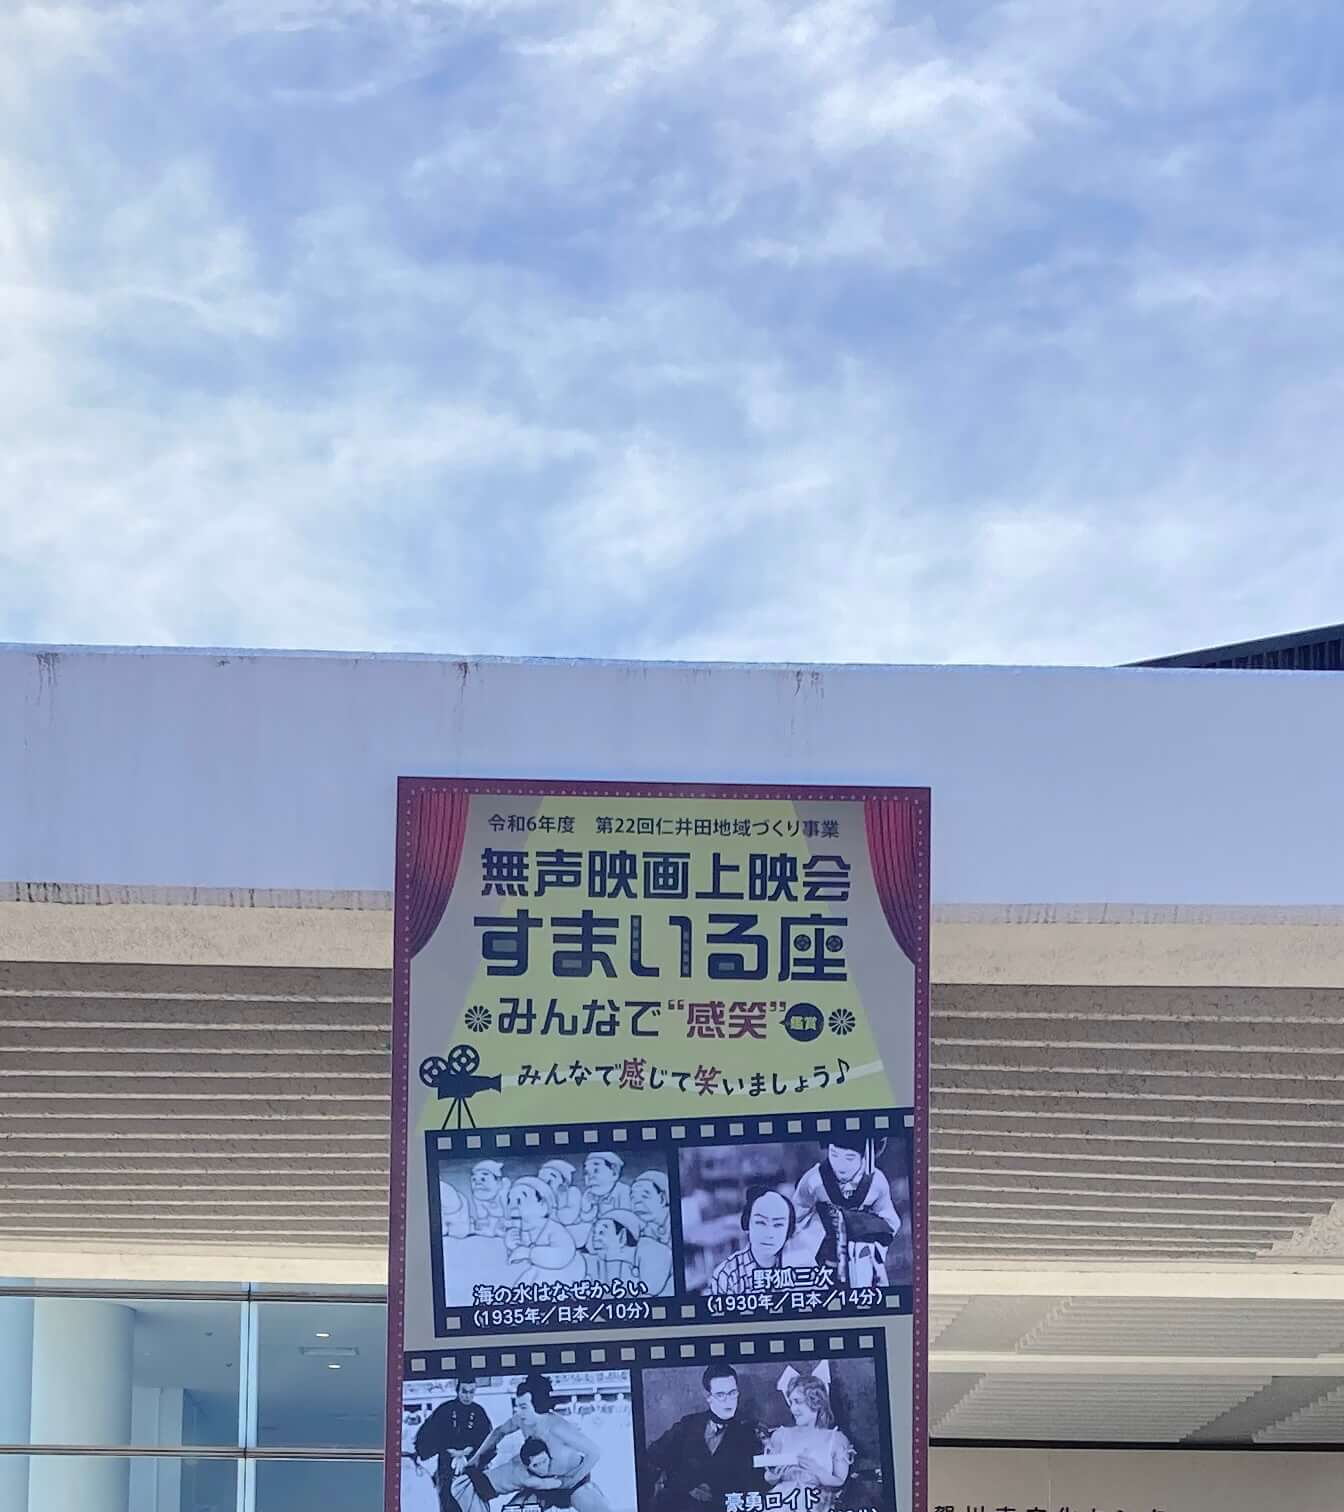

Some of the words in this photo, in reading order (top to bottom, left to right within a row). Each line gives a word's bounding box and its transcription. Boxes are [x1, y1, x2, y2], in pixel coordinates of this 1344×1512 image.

[488, 814, 576, 834] 令和6年度
[595, 816, 840, 839] 第22回仁井田地域づくり事業
[480, 847, 851, 902] 無声映画上映会
[473, 909, 849, 982] すまいる座
[752, 1267, 834, 1290] 野狐三次
[473, 1280, 648, 1306] 海の水はなぜからい
[725, 1490, 821, 1512] 豪勇ロイド
